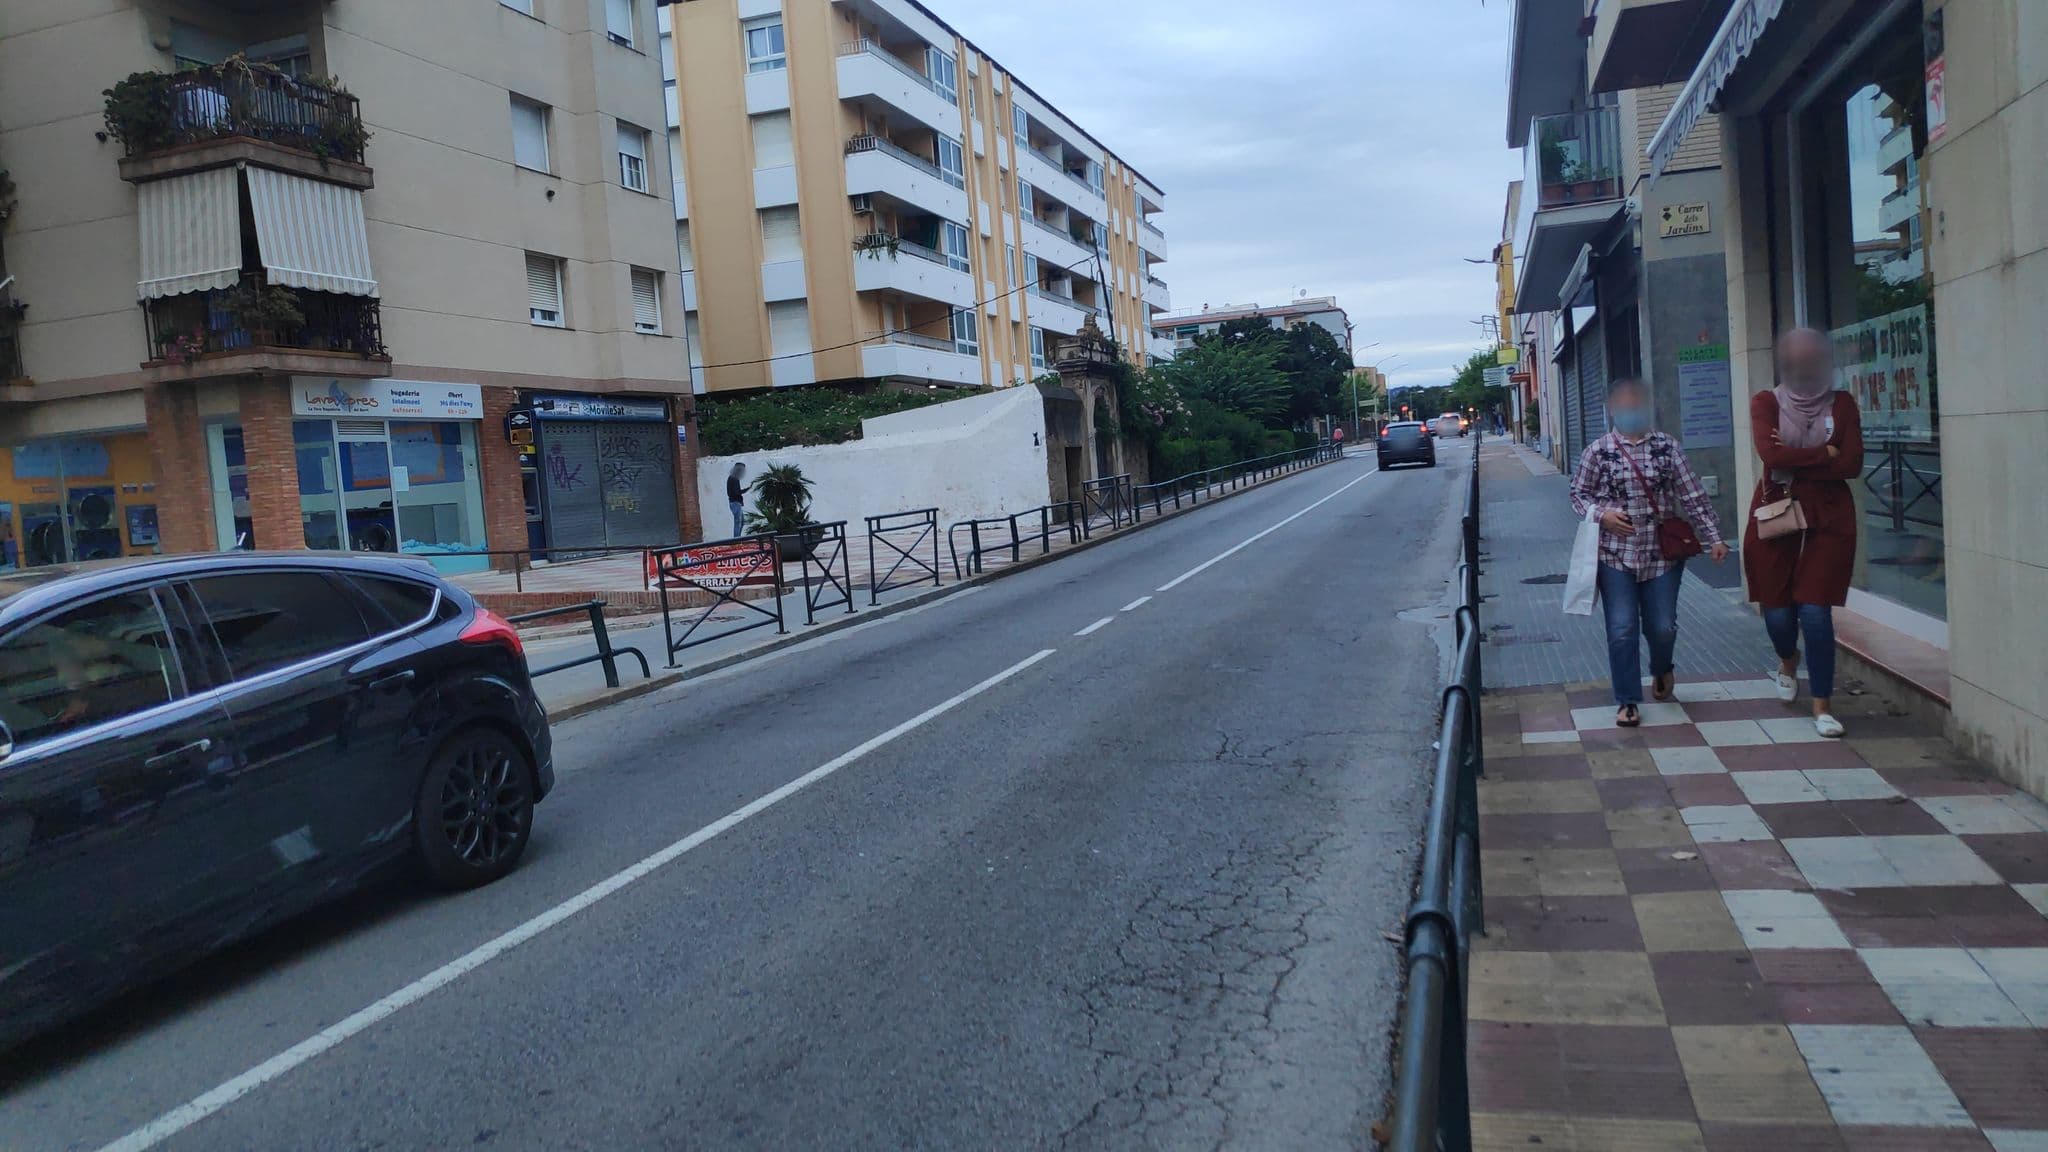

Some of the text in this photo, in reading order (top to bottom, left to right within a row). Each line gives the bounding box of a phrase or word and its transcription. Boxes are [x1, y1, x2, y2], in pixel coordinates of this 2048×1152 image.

[1678, 204, 1704, 214] Carrer
[1684, 214, 1698, 223] dels
[1665, 224, 1704, 235] Jardins
